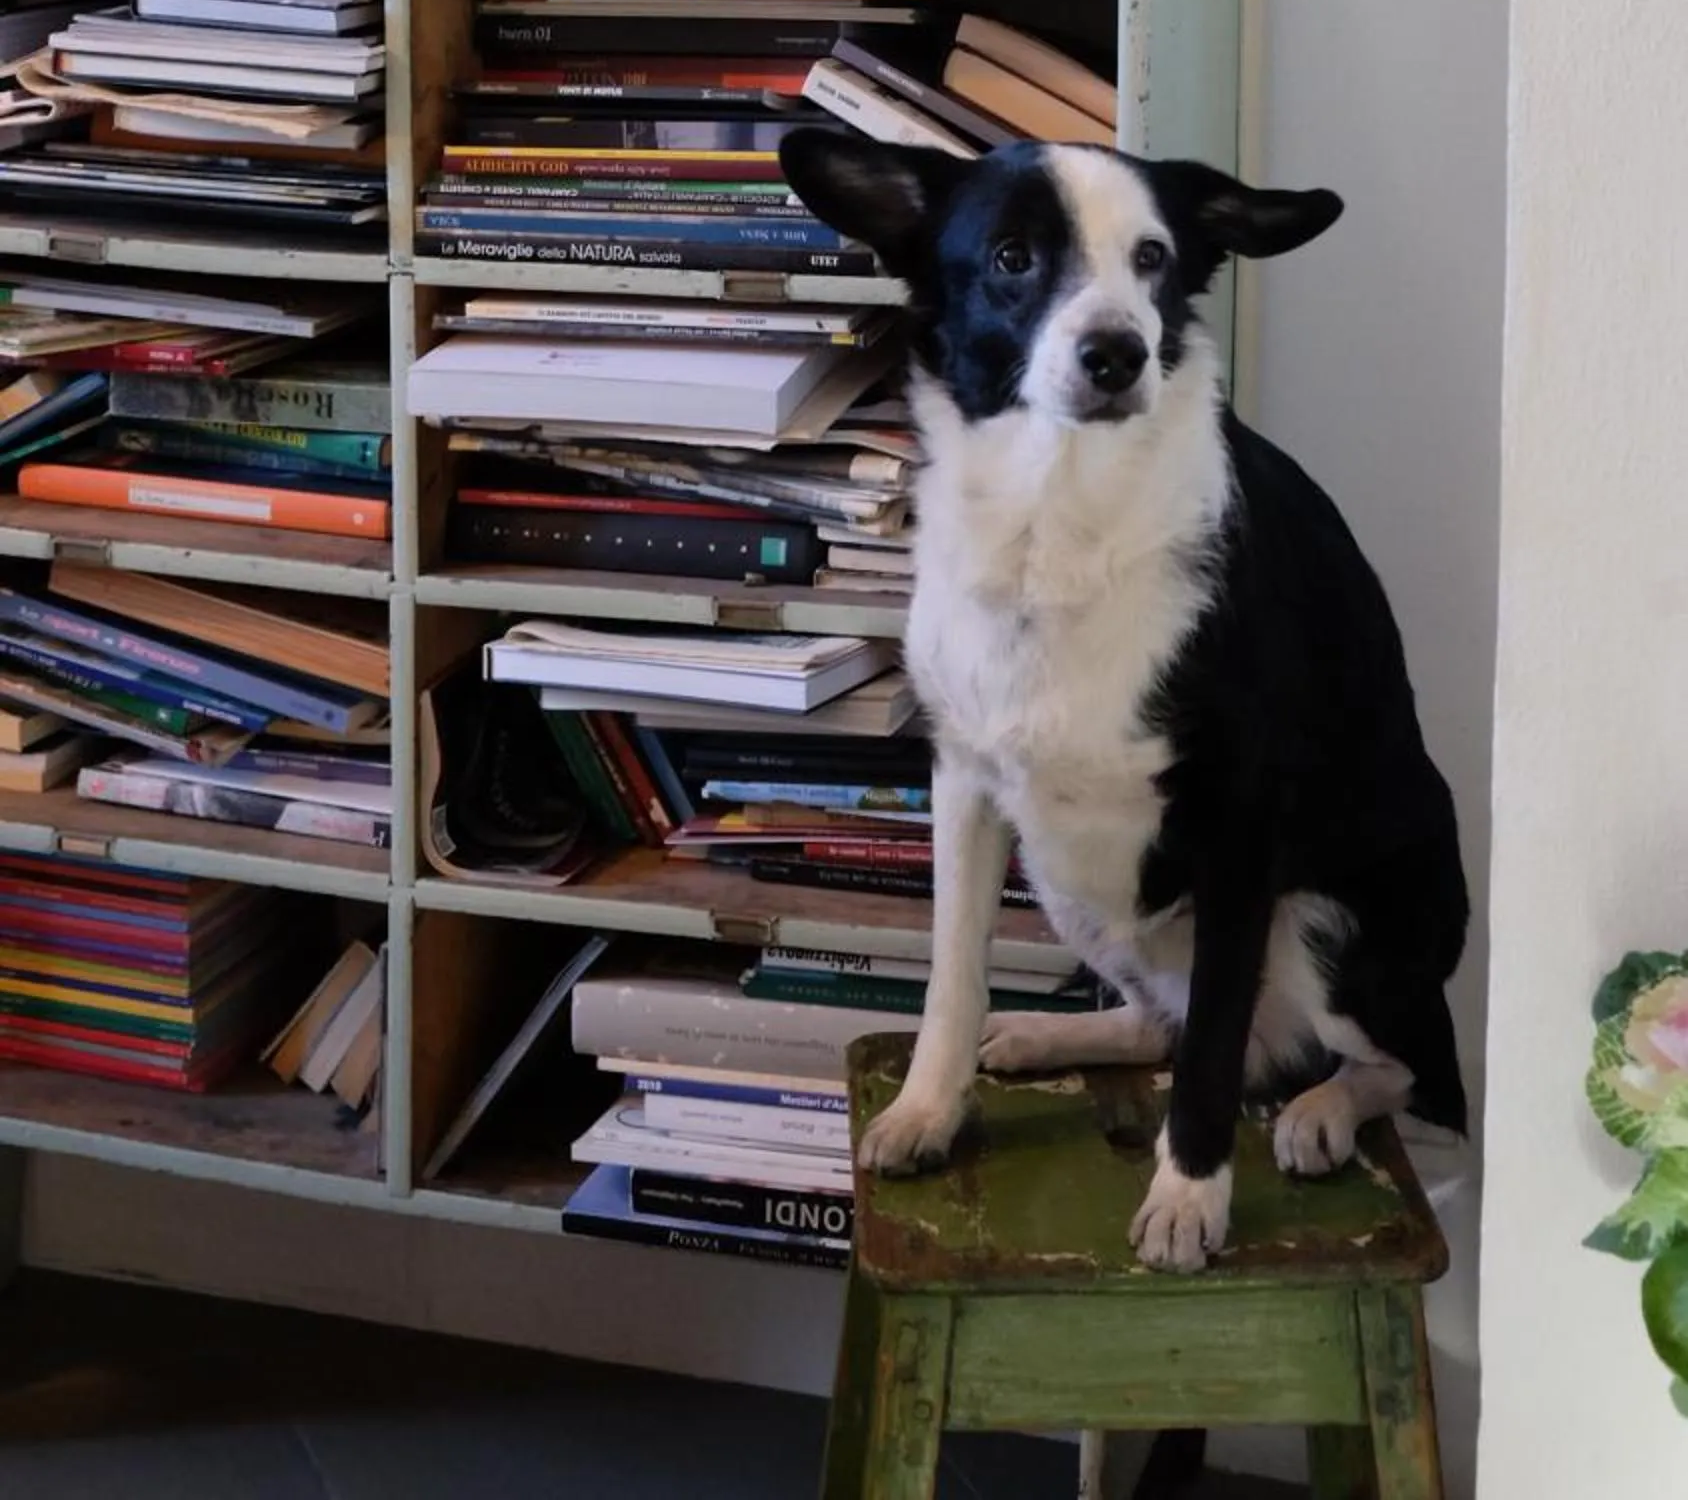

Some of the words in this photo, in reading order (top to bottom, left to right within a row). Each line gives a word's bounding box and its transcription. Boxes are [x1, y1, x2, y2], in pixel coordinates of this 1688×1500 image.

[534, 26, 552, 42] 01
[540, 159, 570, 174] GOD
[441, 242, 456, 256] Le
[457, 240, 535, 263] Meraviglie
[569, 244, 636, 263] NATURA
[639, 250, 682, 265] salvata
[809, 253, 841, 268] UTET
[764, 1198, 853, 1232] ONDI
